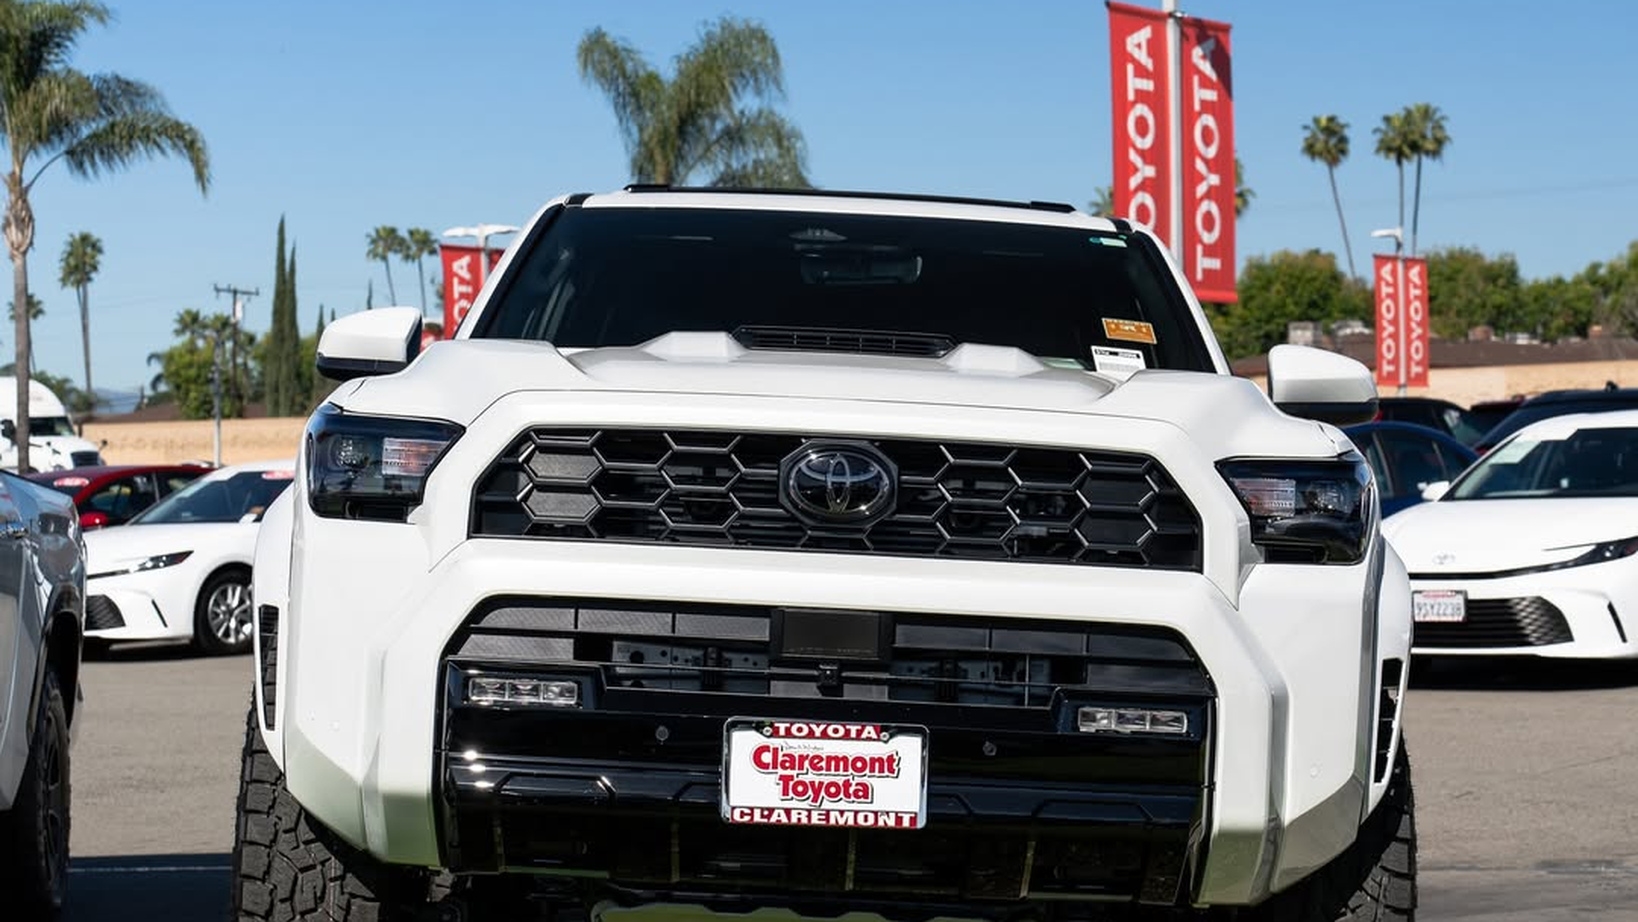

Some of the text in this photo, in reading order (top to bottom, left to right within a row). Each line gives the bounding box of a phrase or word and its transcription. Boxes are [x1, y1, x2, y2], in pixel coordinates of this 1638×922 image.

[1126, 25, 1156, 230] OYOTA
[1192, 37, 1221, 281] TOYOTA
[1381, 262, 1395, 377] TOYOTA
[1408, 265, 1423, 378] TOYOTA
[752, 745, 896, 774] Claremont
[775, 723, 879, 740] TOYOTA
[733, 808, 915, 826] CLAREMONT
[778, 774, 870, 803] Toyota
